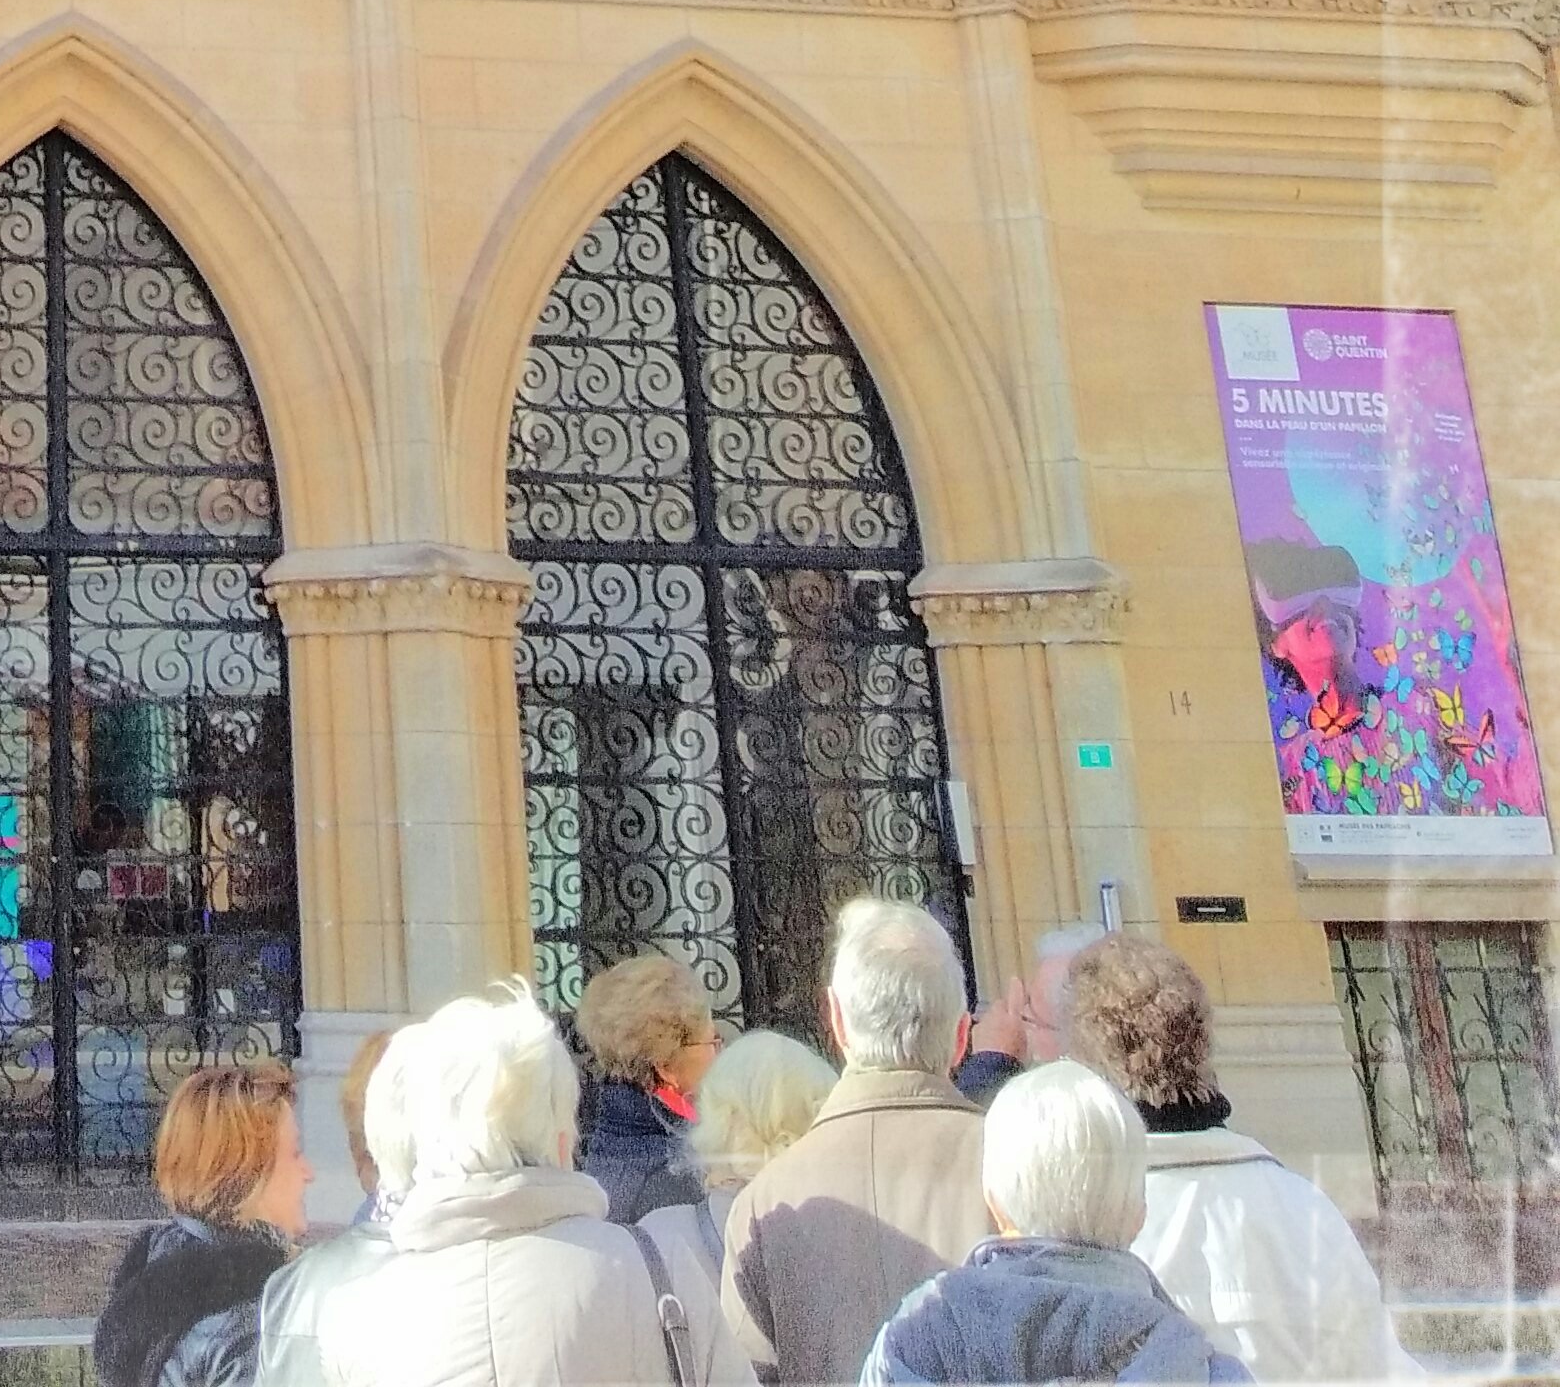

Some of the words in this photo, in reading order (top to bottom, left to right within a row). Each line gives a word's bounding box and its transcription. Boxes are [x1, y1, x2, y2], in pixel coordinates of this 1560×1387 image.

[1332, 335, 1368, 346] SAINT
[1335, 347, 1389, 359] QUENTIN
[1232, 388, 1250, 413] 5
[1259, 389, 1389, 418] MINUTES
[1234, 418, 1264, 429] DANS
[1266, 419, 1280, 430] LA
[1280, 419, 1308, 431] PEAU
[1169, 690, 1192, 716] 14
